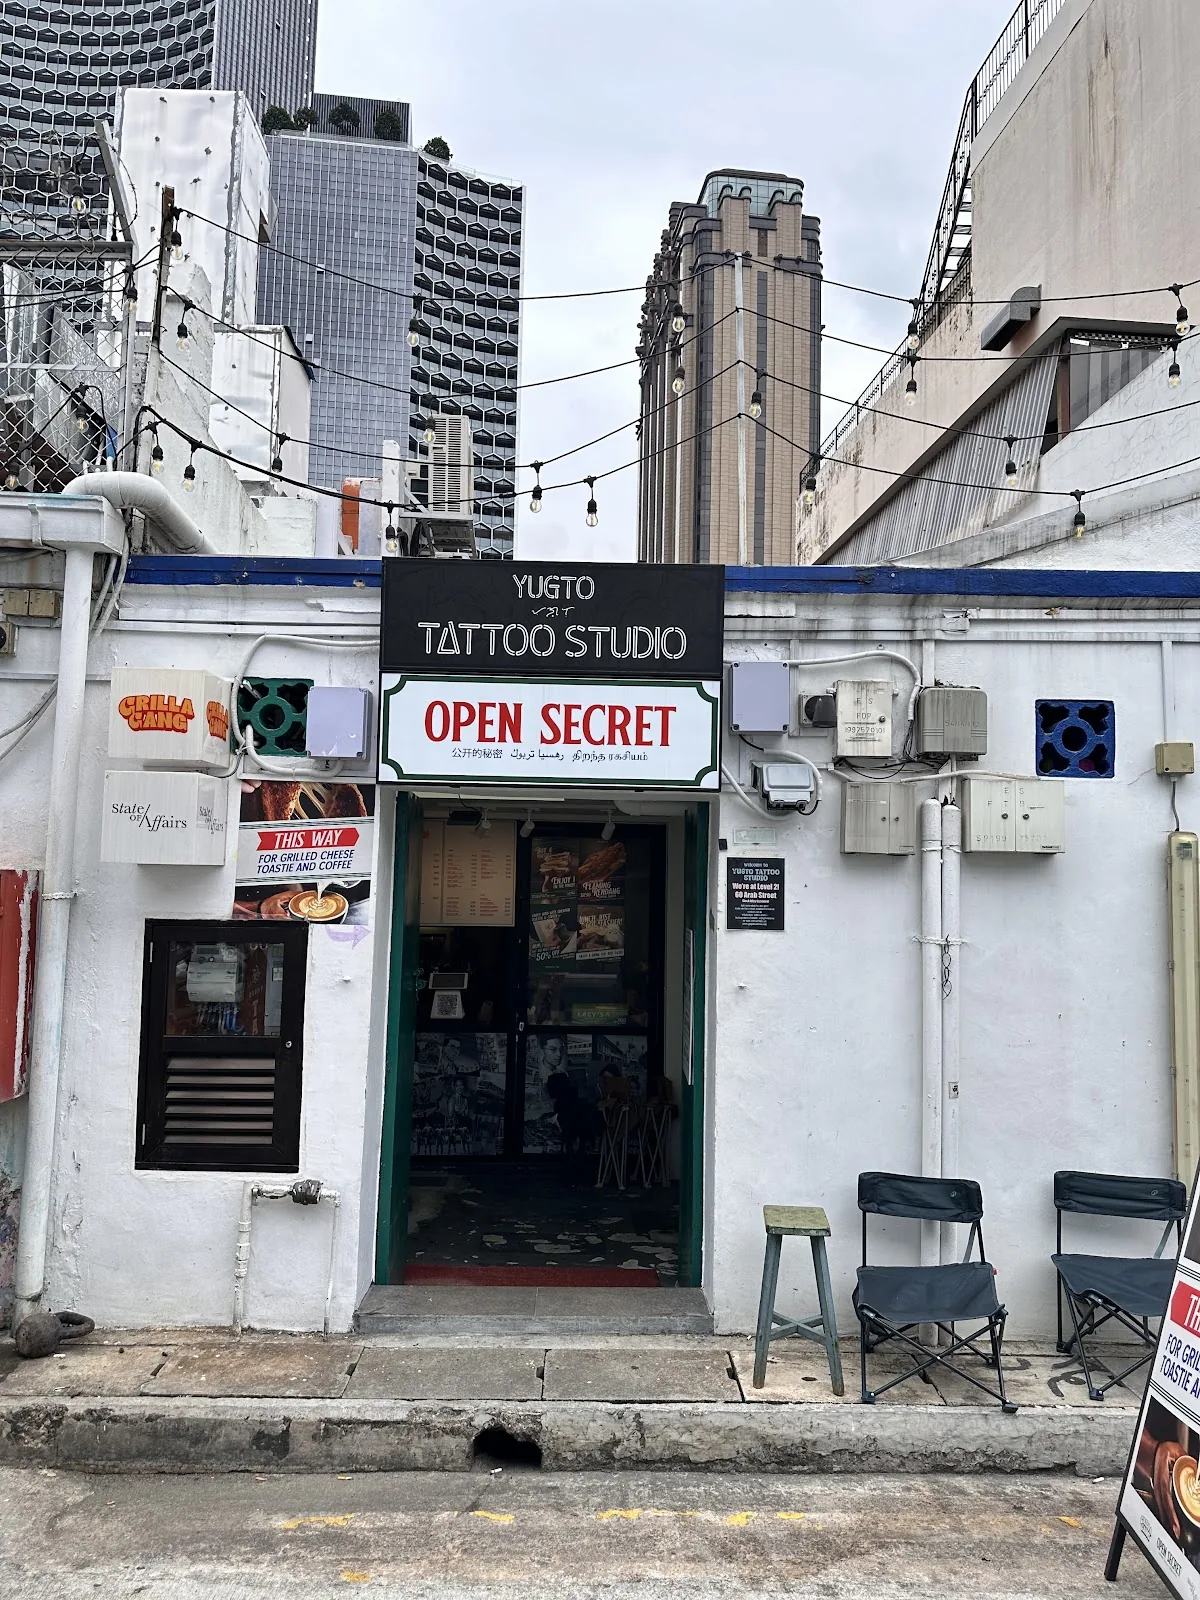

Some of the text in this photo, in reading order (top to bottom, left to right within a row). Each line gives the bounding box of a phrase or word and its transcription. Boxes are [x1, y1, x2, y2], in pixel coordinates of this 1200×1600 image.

[512, 574, 595, 600] YUGTO
[418, 620, 687, 660] TATTOO STUDIO
[118, 694, 195, 720] GRILLA
[127, 711, 188, 734] GANG
[424, 700, 677, 747] OPEN SECRET
[452, 748, 502, 758] 公开的秘密
[111, 803, 145, 814] State
[274, 829, 343, 848] THIS WAY
[257, 860, 352, 874] TOASTIE AND COFFEE
[258, 849, 354, 864] FOR GRILLED CHEESE
[551, 876, 572, 884] ENJOY
[536, 952, 551, 961] 50%
[1165, 1333, 1182, 1358] FOR
[1160, 1355, 1192, 1392] TOASTIE
